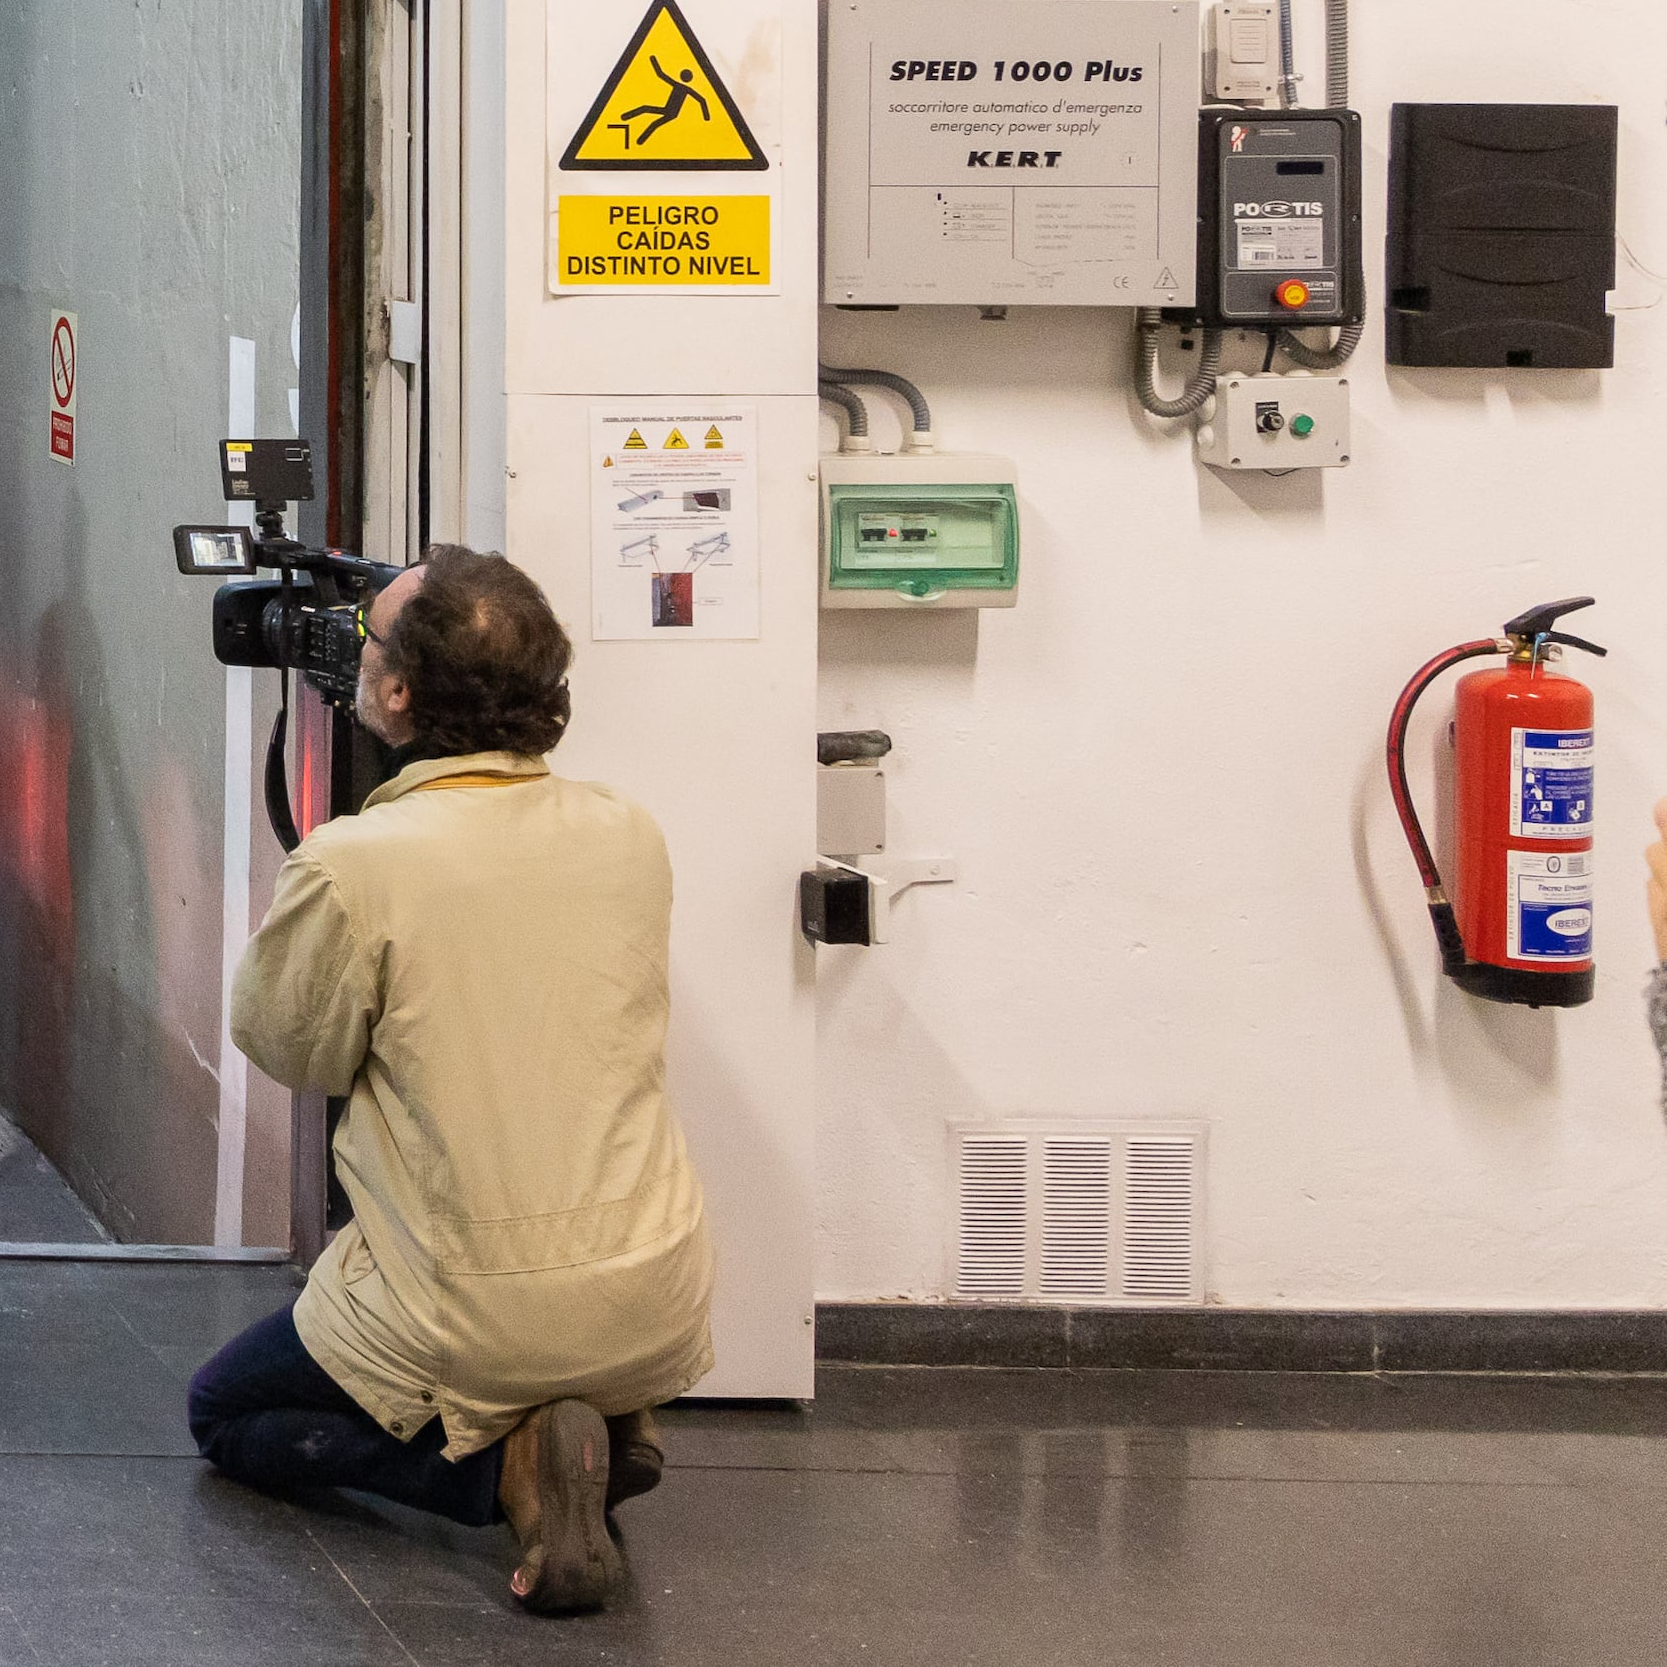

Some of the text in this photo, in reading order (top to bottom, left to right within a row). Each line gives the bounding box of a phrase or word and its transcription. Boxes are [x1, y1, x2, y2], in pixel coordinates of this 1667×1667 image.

[889, 60, 1143, 82] SPEED 1000 Plus
[888, 98, 1142, 118] soccorritore automatico d'emergenza
[929, 118, 1101, 137] emergency power supply
[609, 206, 719, 225] PELIGRO
[617, 226, 710, 250] CAÍDAS
[567, 256, 760, 275] DISTINTO NIVEL
